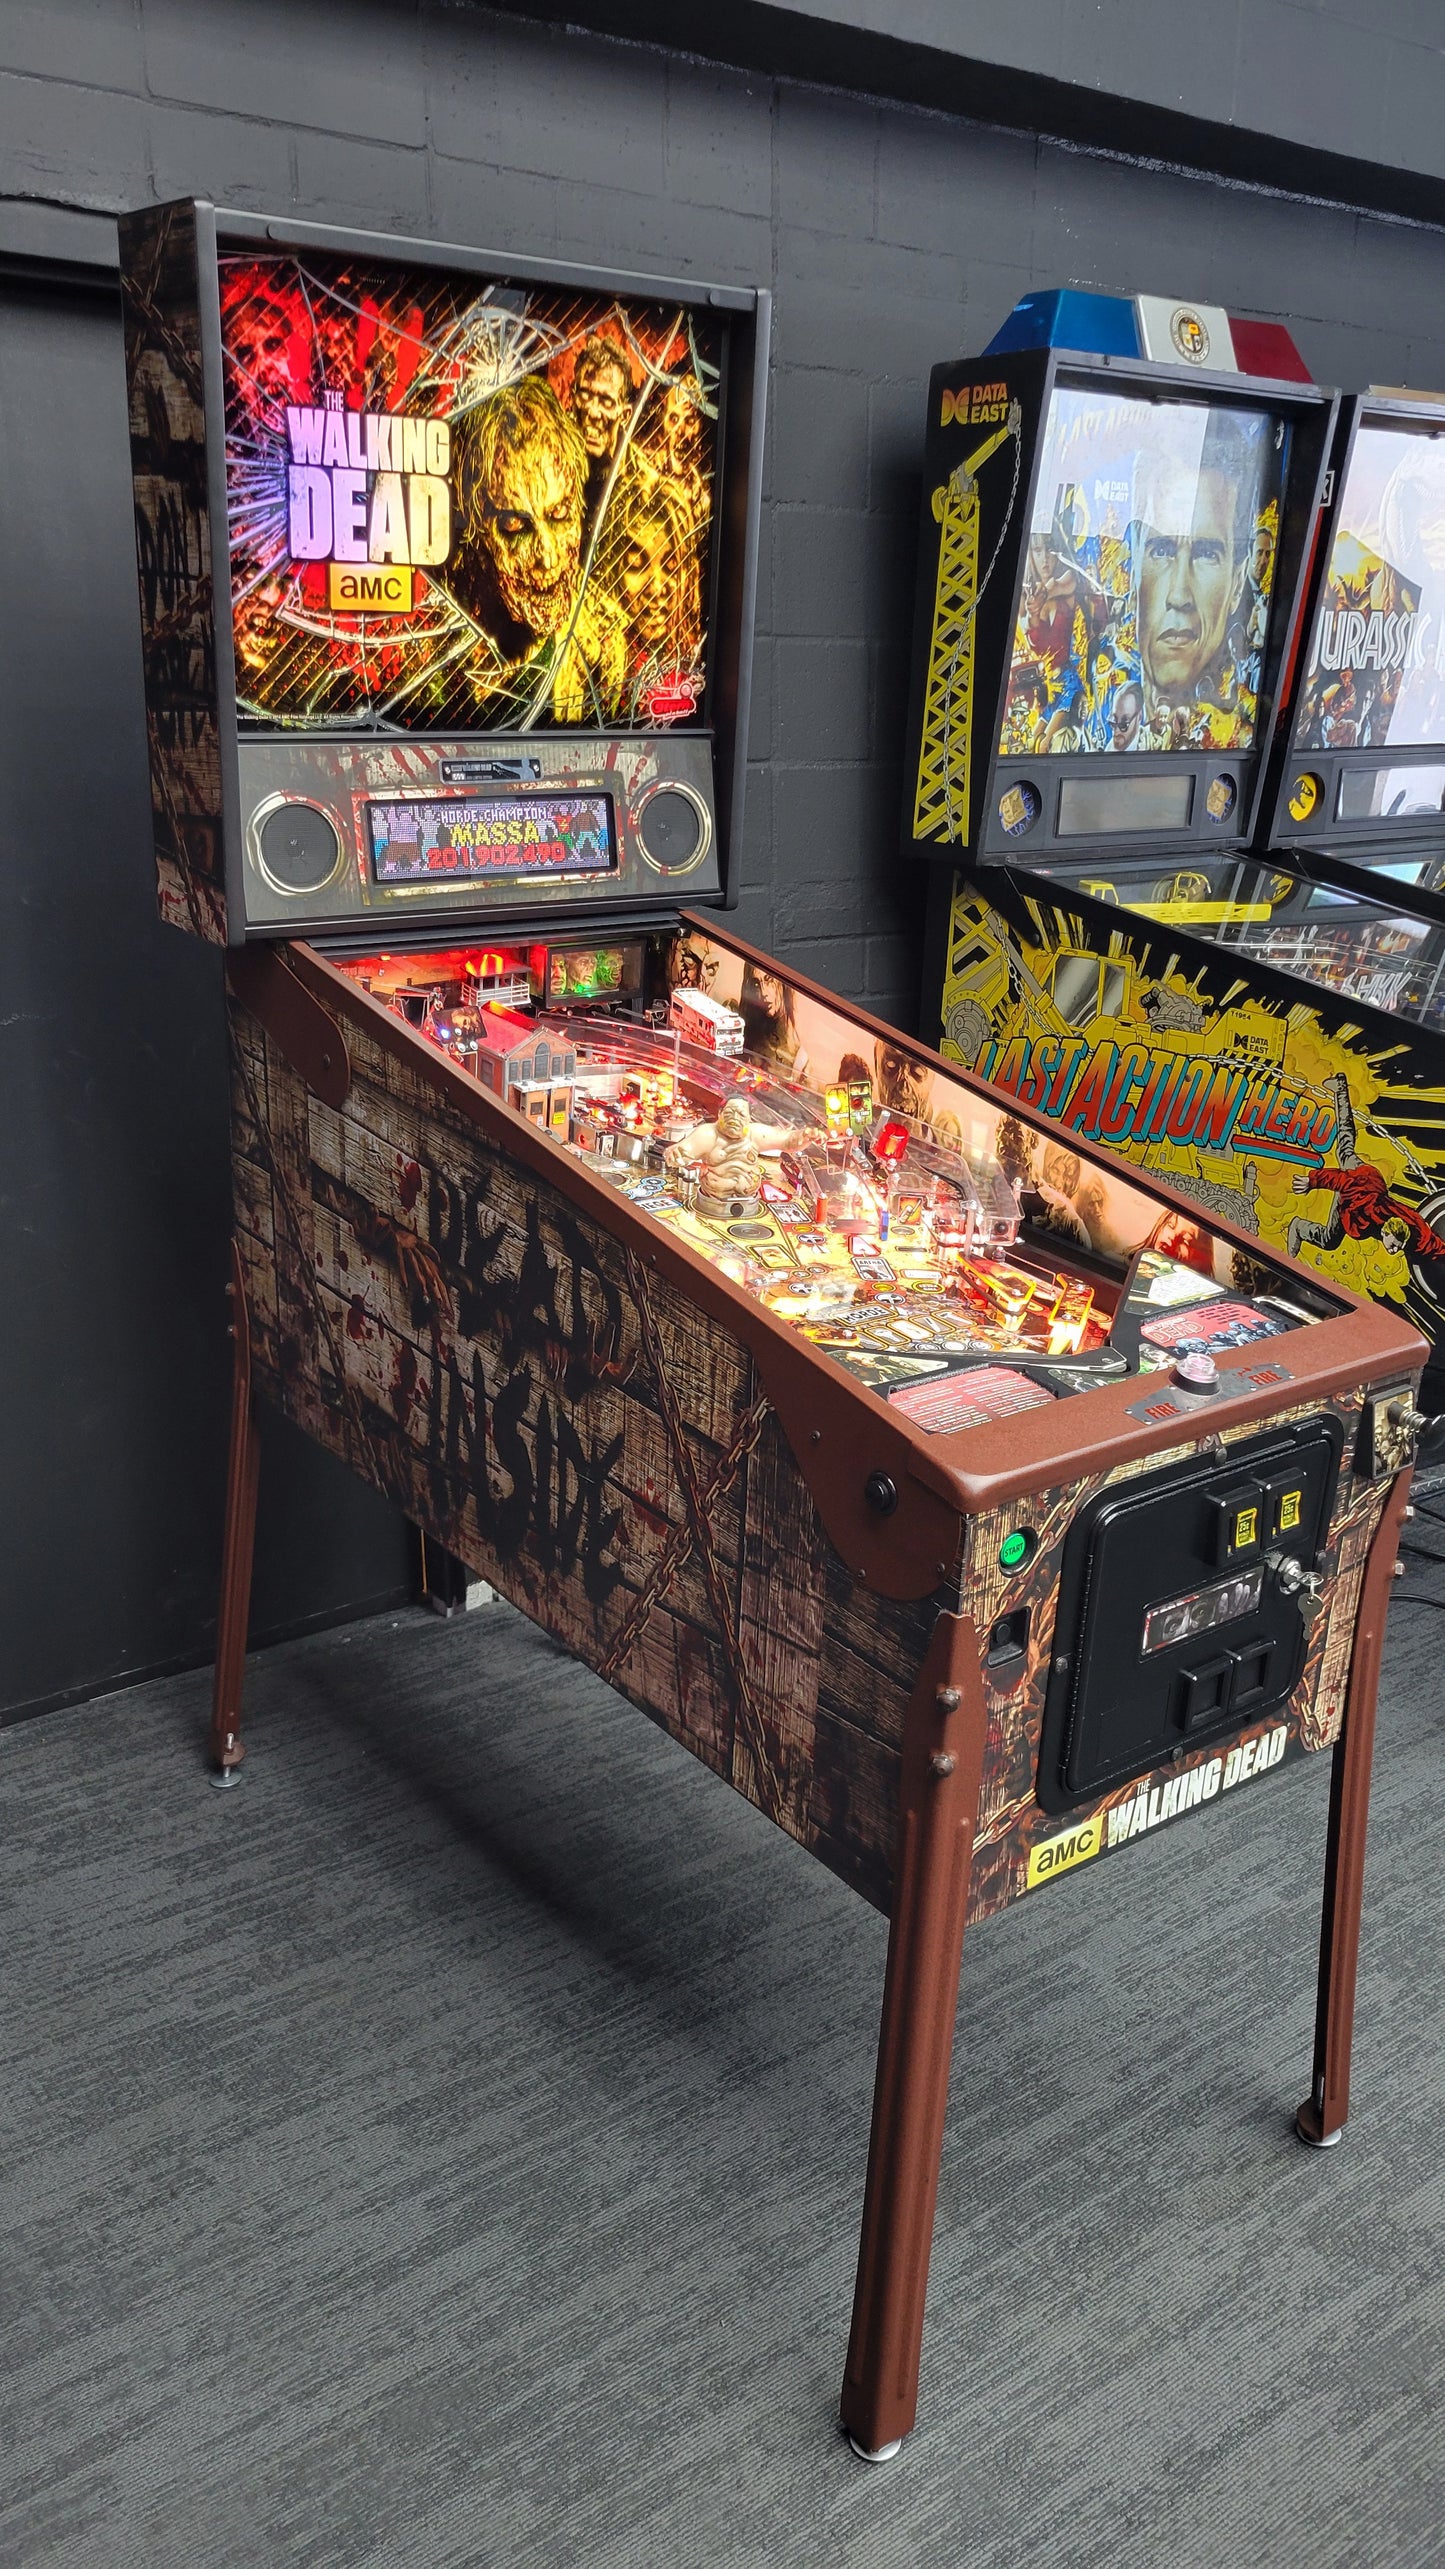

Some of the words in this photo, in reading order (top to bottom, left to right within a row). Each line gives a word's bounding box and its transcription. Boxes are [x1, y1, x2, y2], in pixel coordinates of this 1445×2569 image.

[324, 390, 344, 412] THE
[973, 383, 1007, 403] DATA
[971, 402, 1008, 424] EAST
[287, 406, 450, 476] WALKING
[1110, 481, 1129, 491] DATA
[289, 464, 450, 566] DEAD
[1308, 606, 1432, 678] JURASSIC
[441, 808, 478, 823] HORDE
[484, 806, 548, 822] CHAMPION
[450, 820, 541, 847] MASSA
[426, 841, 565, 870] 201,902,490
[1249, 1044, 1269, 1055] EAST
[1250, 1036, 1269, 1047] DATA
[973, 1035, 1088, 1117] LAST
[1061, 1039, 1249, 1148] ACTION
[1238, 1081, 1339, 1152] HERO
[429, 1165, 622, 1376] DEAD
[843, 1307, 888, 1321] HORDE
[1145, 1319, 1205, 1344] DEAD
[1248, 1370, 1282, 1386] FIRE
[1145, 1402, 1181, 1420] FIRE
[1004, 1543, 1024, 1558] START
[1107, 1757, 1222, 1849] WALKING
[1222, 1725, 1288, 1791] DEAD
[1136, 1777, 1151, 1796] THE
